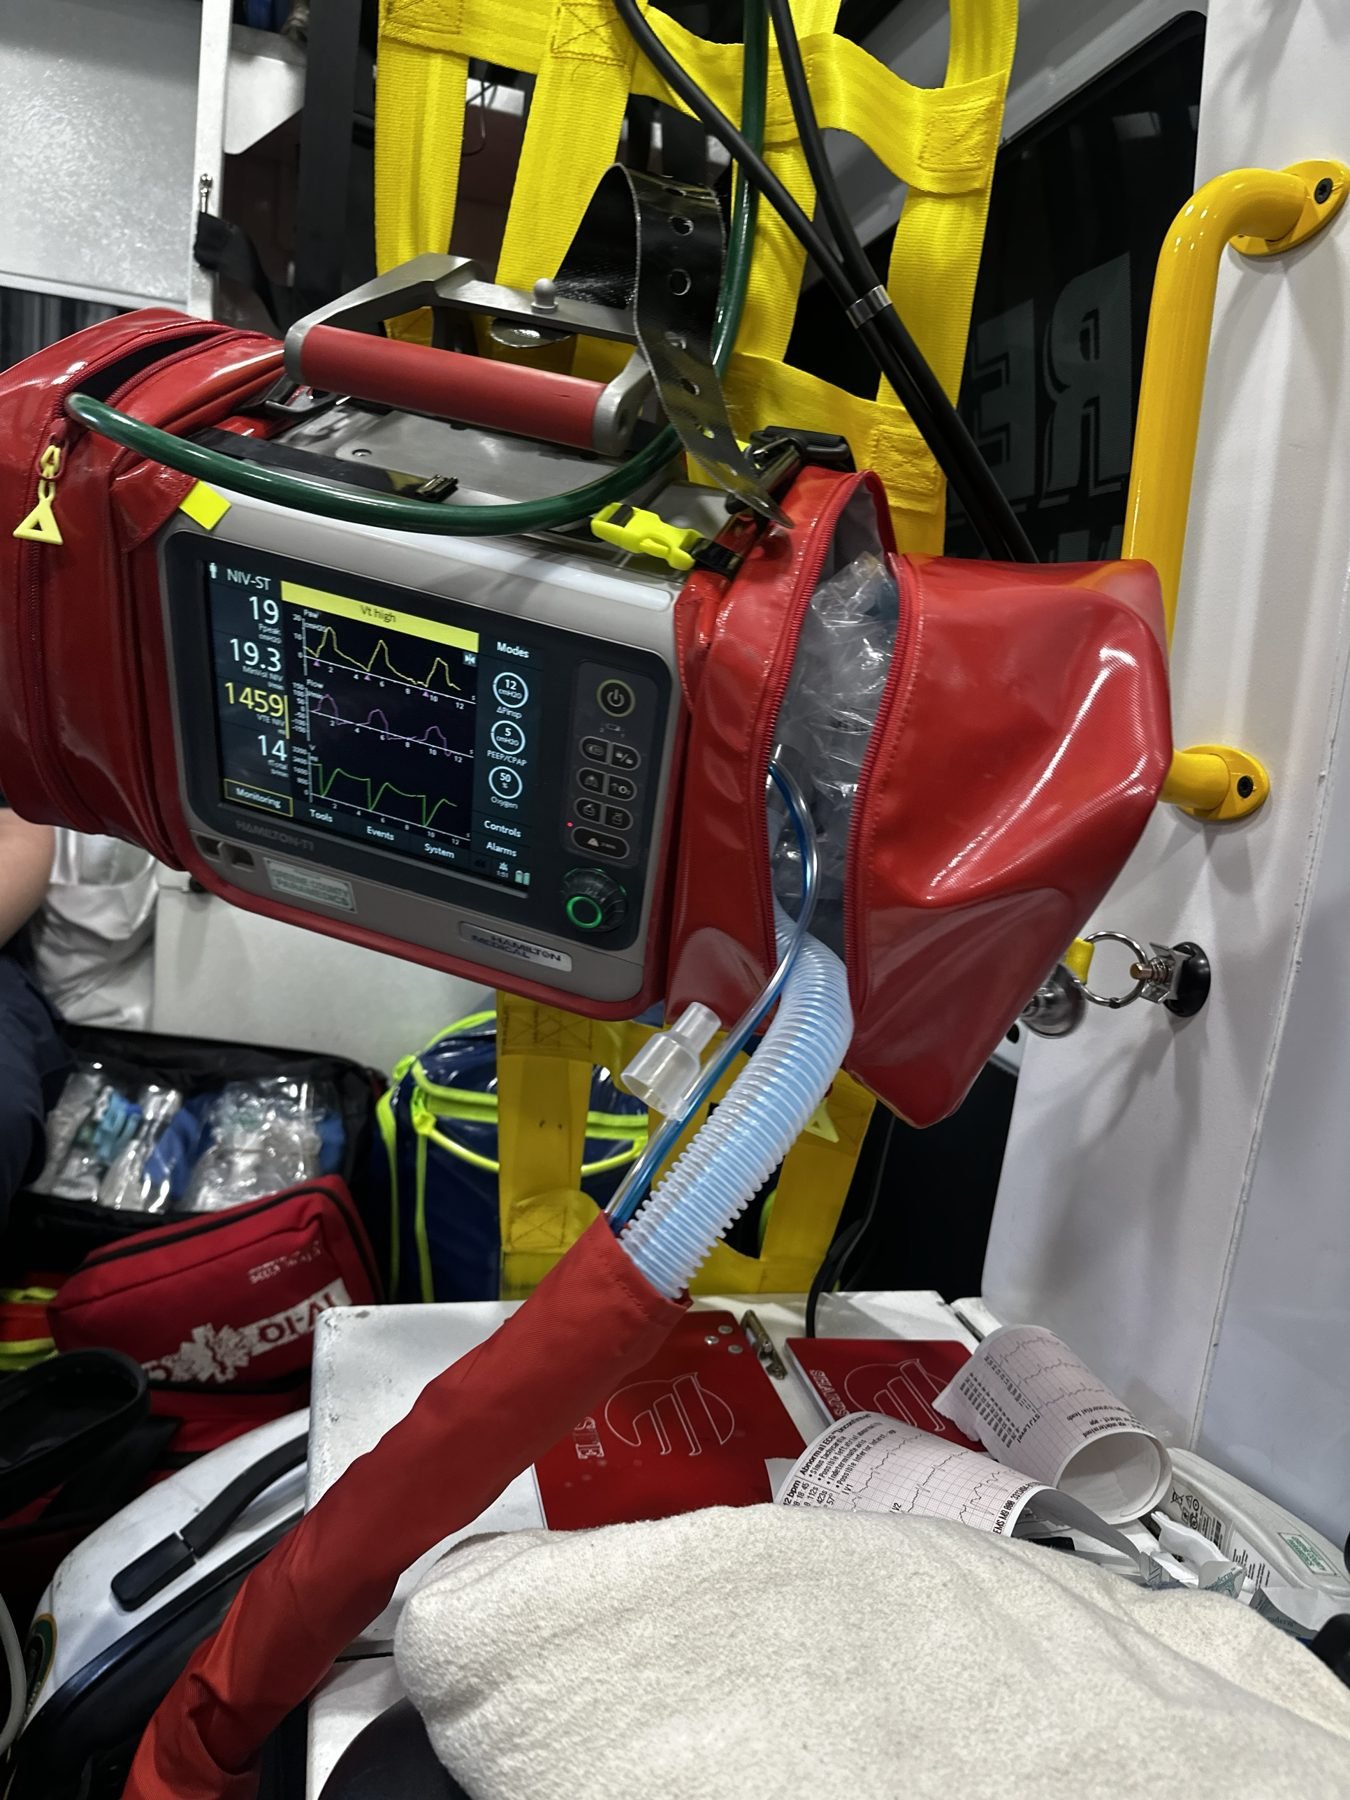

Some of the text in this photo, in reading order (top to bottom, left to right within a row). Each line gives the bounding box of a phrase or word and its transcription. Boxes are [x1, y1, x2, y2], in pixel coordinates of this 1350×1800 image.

[227, 568, 271, 590] NIV-ST
[249, 596, 279, 624] 19
[360, 605, 396, 623] Vt high
[230, 638, 281, 672] 19.3
[496, 641, 530, 658] Modes
[306, 679, 324, 688] Flow
[505, 679, 517, 690] 12
[225, 682, 284, 718] 1459
[430, 694, 439, 702] 10
[455, 702, 465, 710] 12
[504, 727, 512, 737] 5
[258, 735, 288, 761] 14
[429, 748, 438, 756] 10
[454, 755, 463, 764] 12
[487, 750, 528, 767] PEEP/CPAP
[500, 772, 512, 783] 50
[235, 787, 282, 809] Monitoring
[490, 796, 519, 810] Oxygen
[309, 808, 333, 822] Tools
[366, 826, 395, 842] Events
[484, 820, 522, 838] Controls
[452, 838, 461, 846] 12
[486, 841, 518, 857] Alarms
[424, 843, 455, 859] System
[471, 934, 531, 959] MEDICAL
[491, 936, 562, 962] HAMILTON
[800, 1443, 826, 1475] Abnormal
[823, 1434, 836, 1447] ECG
[811, 1436, 847, 1475] Sinus tachycardia
[820, 1455, 839, 1478] Possible
[836, 1445, 849, 1458] left
[830, 1439, 867, 1480] Indeterminate axis
[839, 1461, 857, 1485] Possible
[855, 1444, 872, 1461] inferior
[788, 1480, 801, 1498] bpm
[993, 1519, 1006, 1535] EMS
